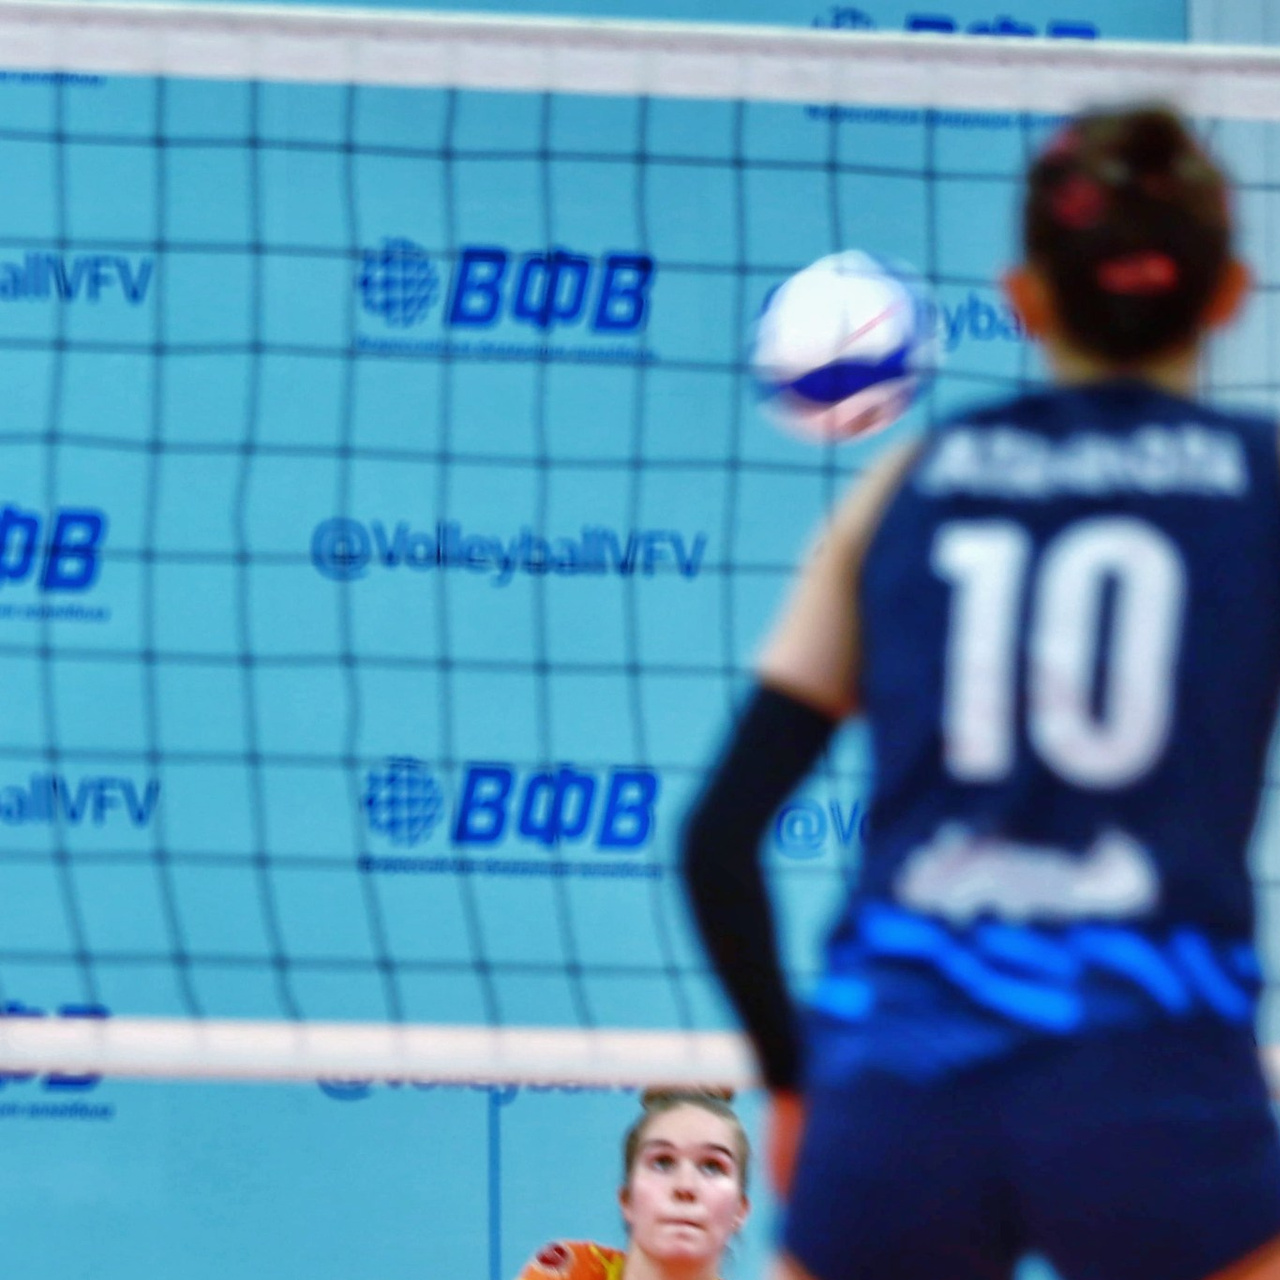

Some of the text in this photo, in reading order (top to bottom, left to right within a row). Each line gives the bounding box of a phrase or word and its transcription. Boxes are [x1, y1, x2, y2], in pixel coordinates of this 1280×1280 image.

[447, 246, 655, 334] ВФВ
[310, 516, 708, 588] @VolleyballVFV
[930, 513, 1187, 790] 10
[450, 763, 660, 849] ВФВ
